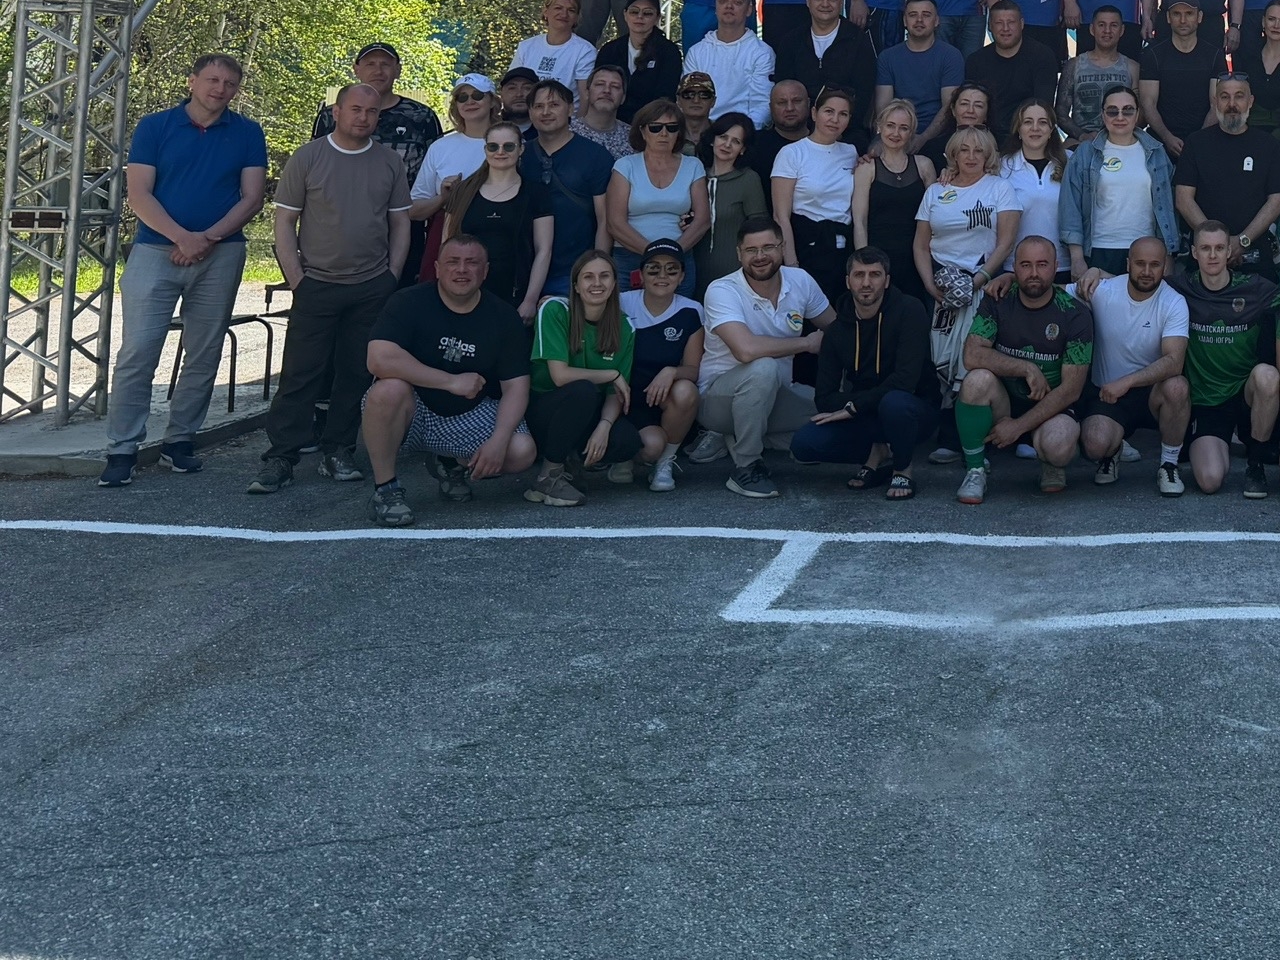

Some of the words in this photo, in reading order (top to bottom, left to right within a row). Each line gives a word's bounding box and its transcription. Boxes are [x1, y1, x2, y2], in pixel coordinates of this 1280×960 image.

[1077, 73, 1127, 83] AUTHENTIC
[1225, 324, 1248, 334] ПАЛАТА
[440, 336, 476, 353] adidas
